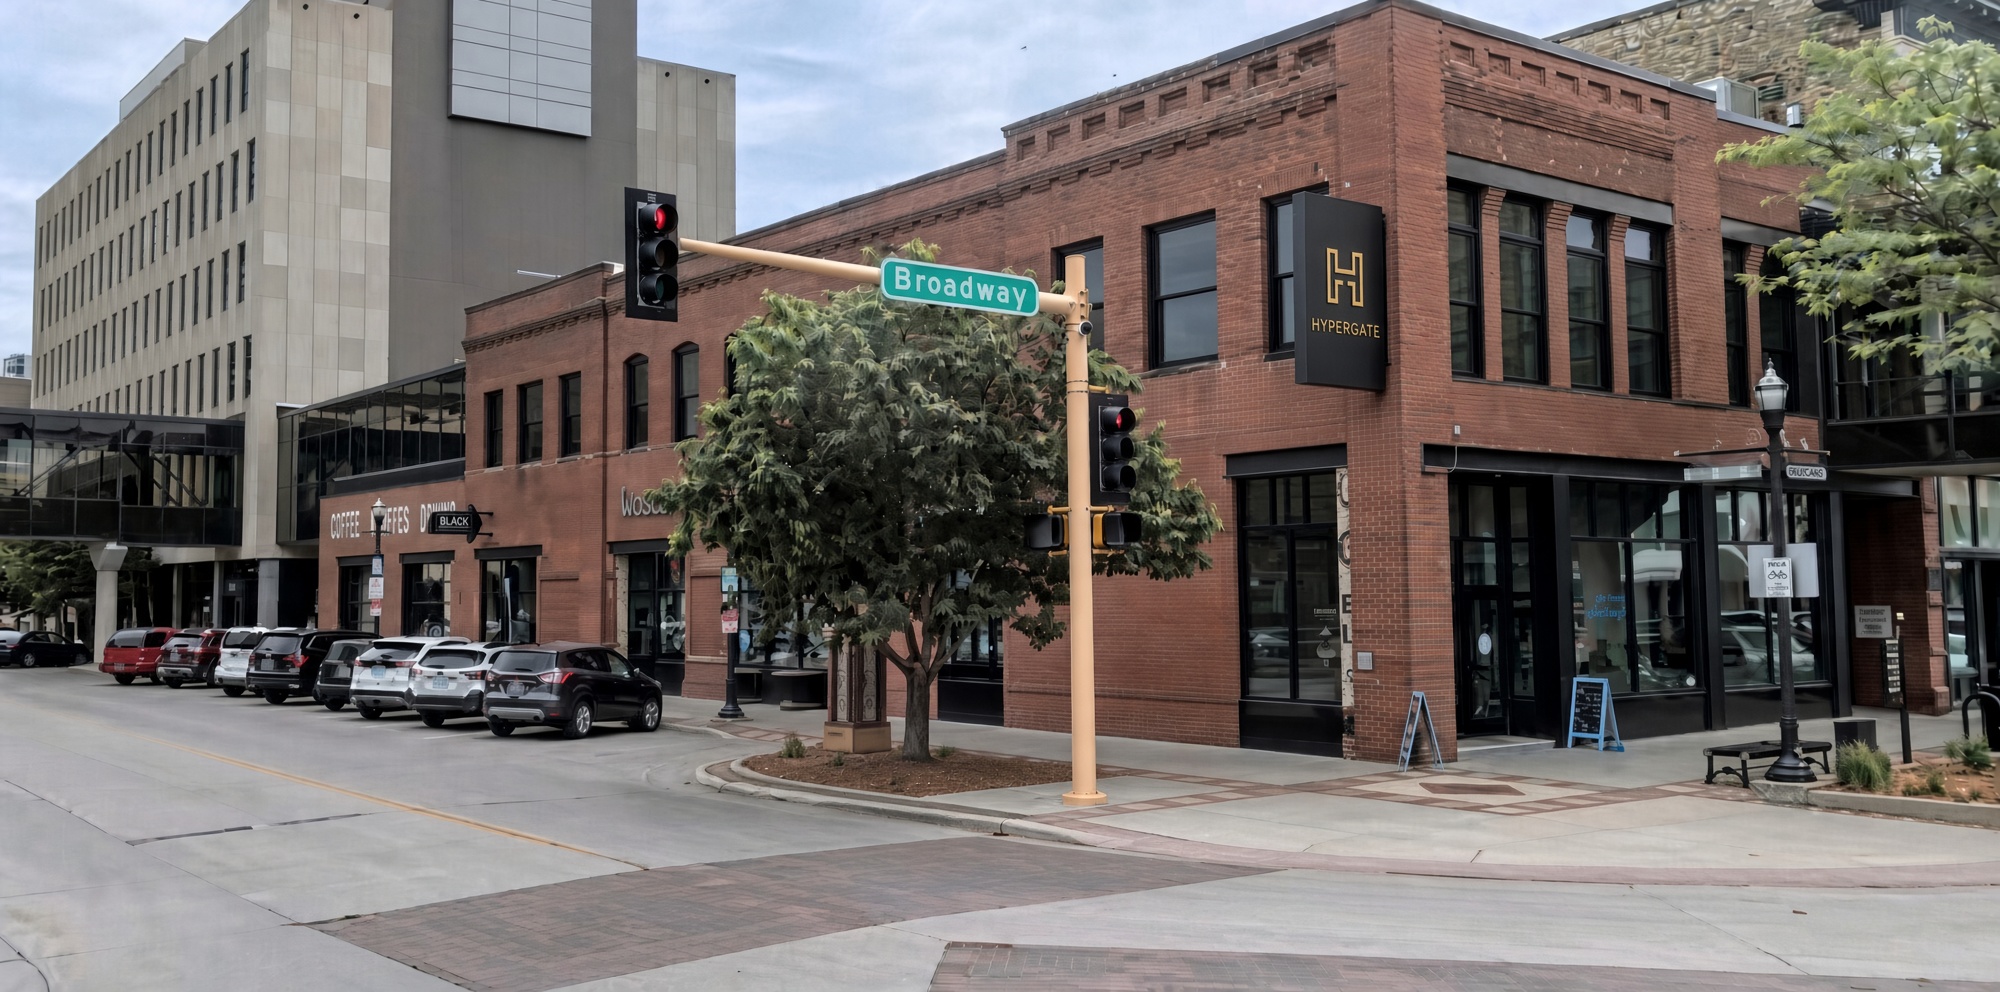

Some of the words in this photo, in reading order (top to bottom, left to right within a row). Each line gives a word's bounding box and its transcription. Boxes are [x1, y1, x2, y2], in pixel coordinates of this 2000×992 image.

[894, 265, 1027, 311] Broadway
[1311, 317, 1381, 339] HYPERGATE
[331, 510, 360, 540] COFFEE
[440, 516, 469, 526] BLACK
